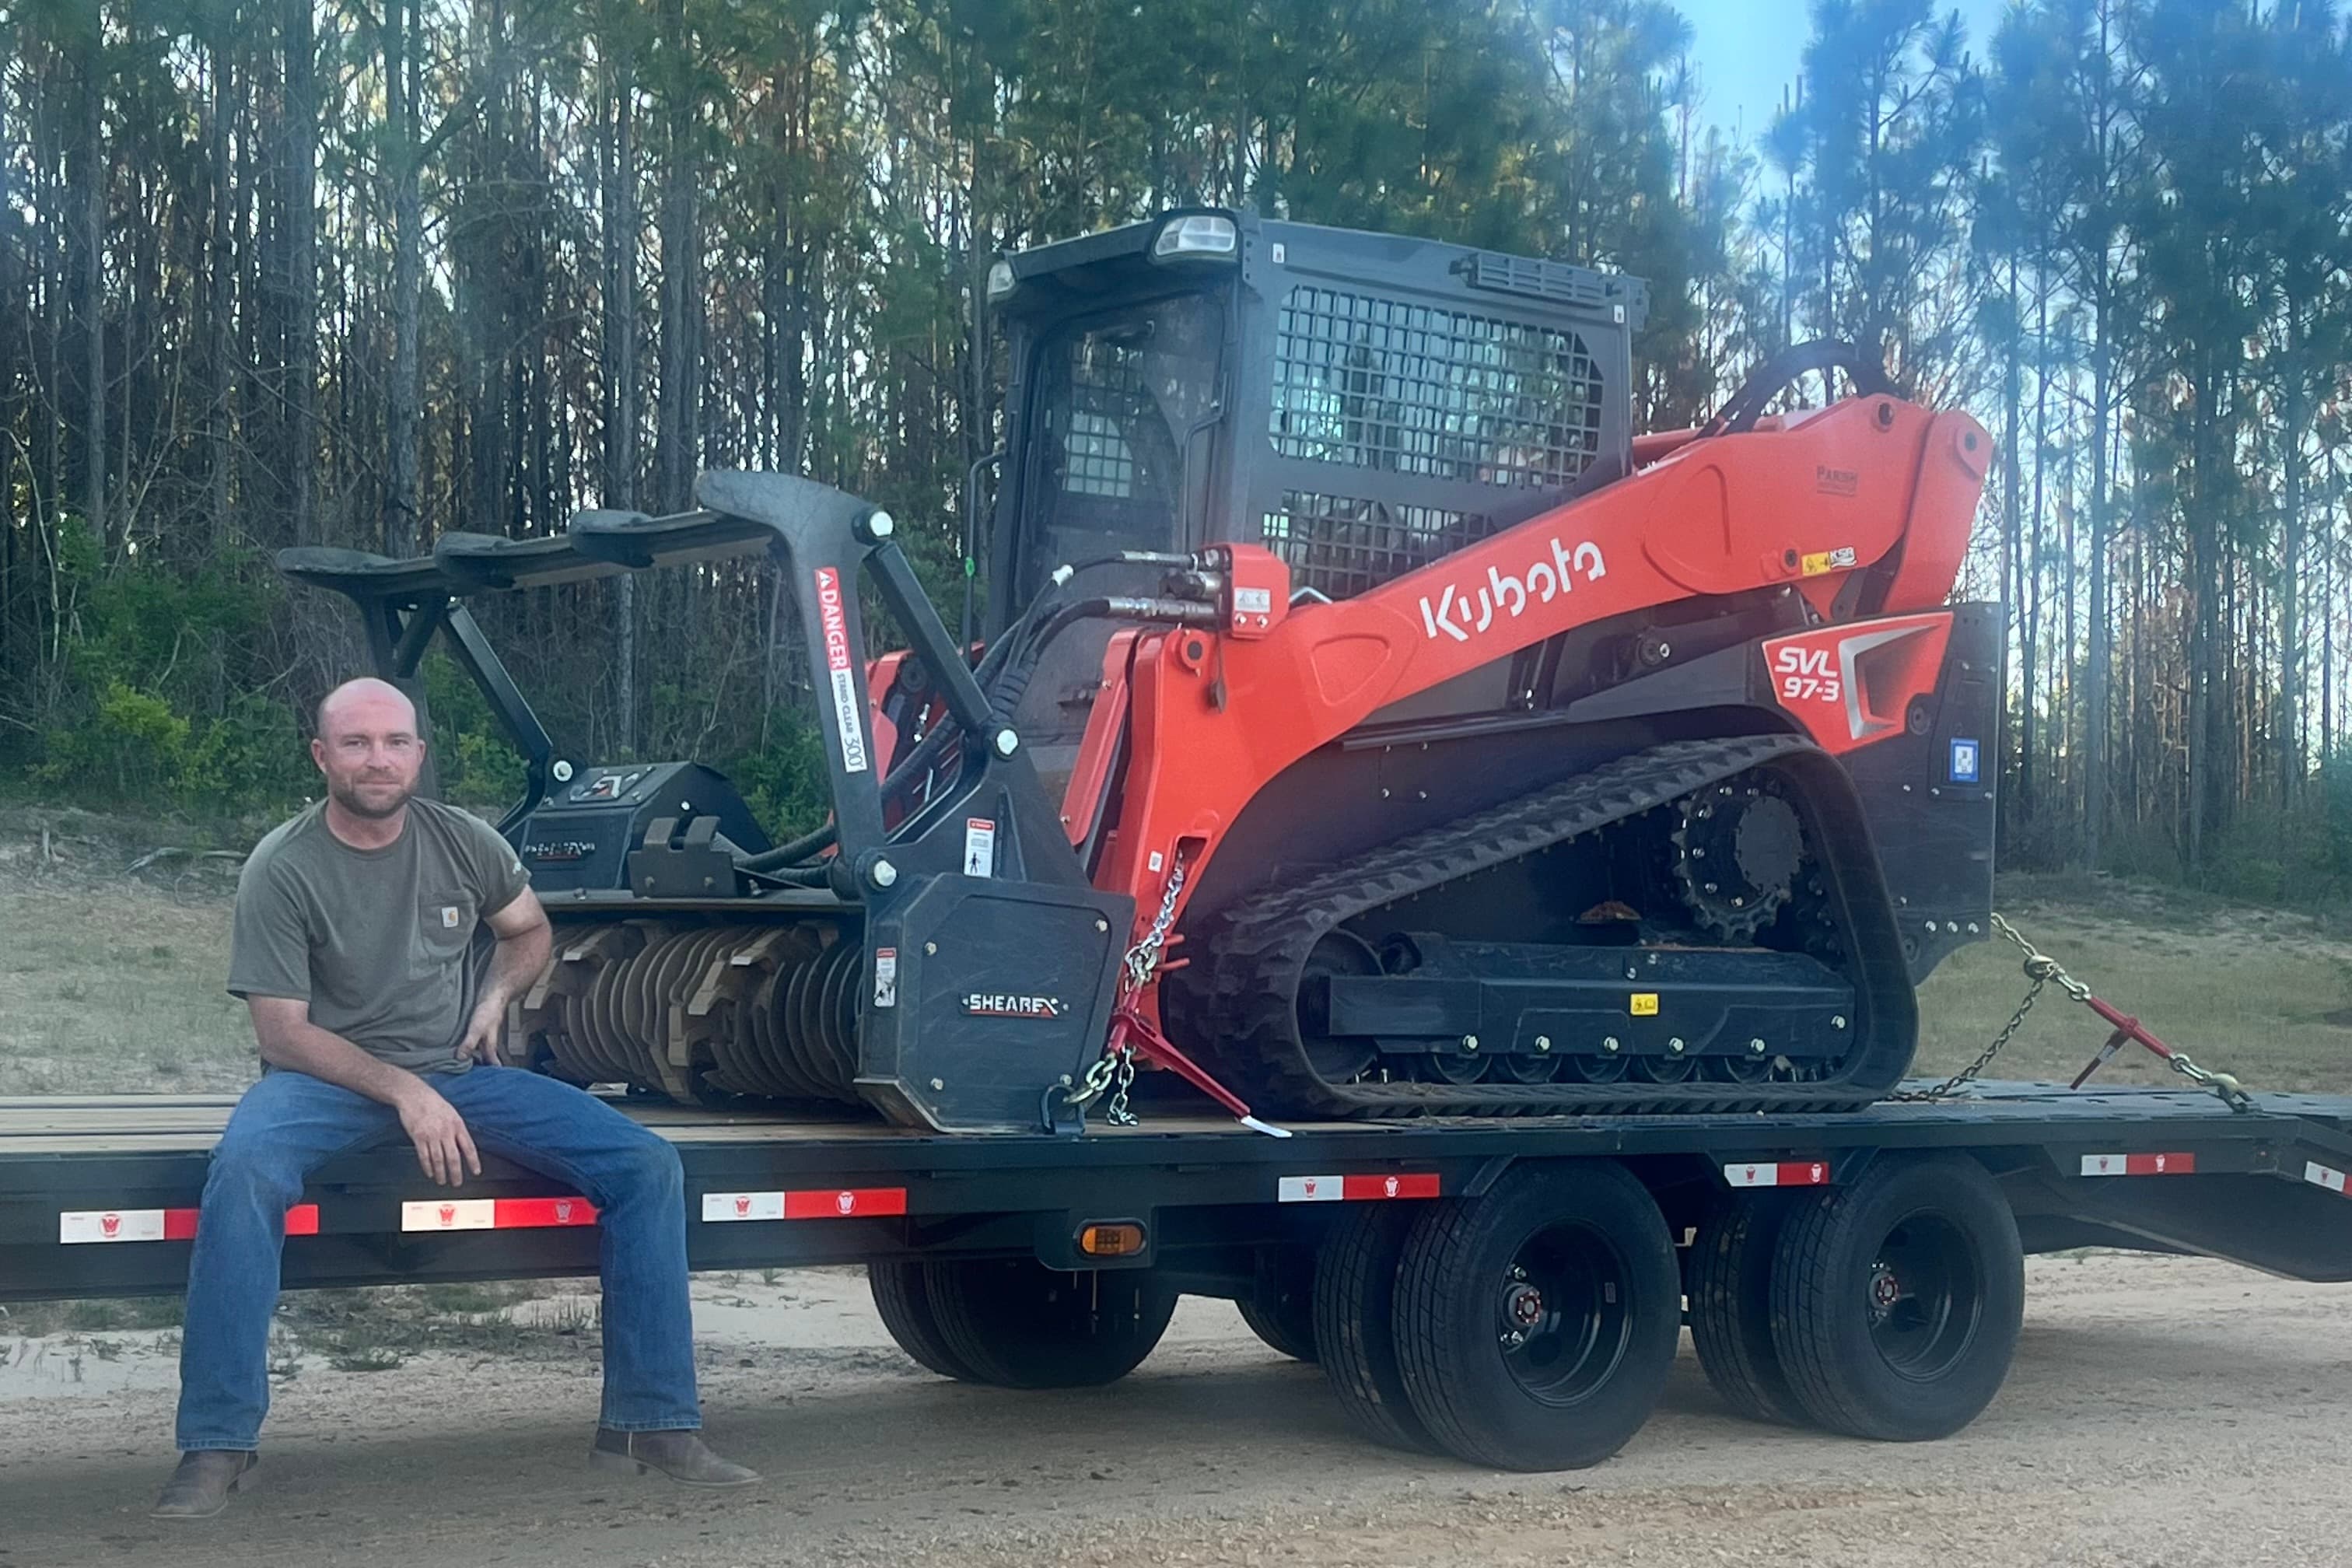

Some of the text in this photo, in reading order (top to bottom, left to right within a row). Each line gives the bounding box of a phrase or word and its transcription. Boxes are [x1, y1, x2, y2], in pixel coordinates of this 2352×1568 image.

[1419, 537, 1607, 642] Kubota
[821, 589, 848, 670] DANGER
[842, 705, 854, 733] CLEAR
[1774, 646, 1839, 678] SVL
[1783, 676, 1840, 702] 97-3
